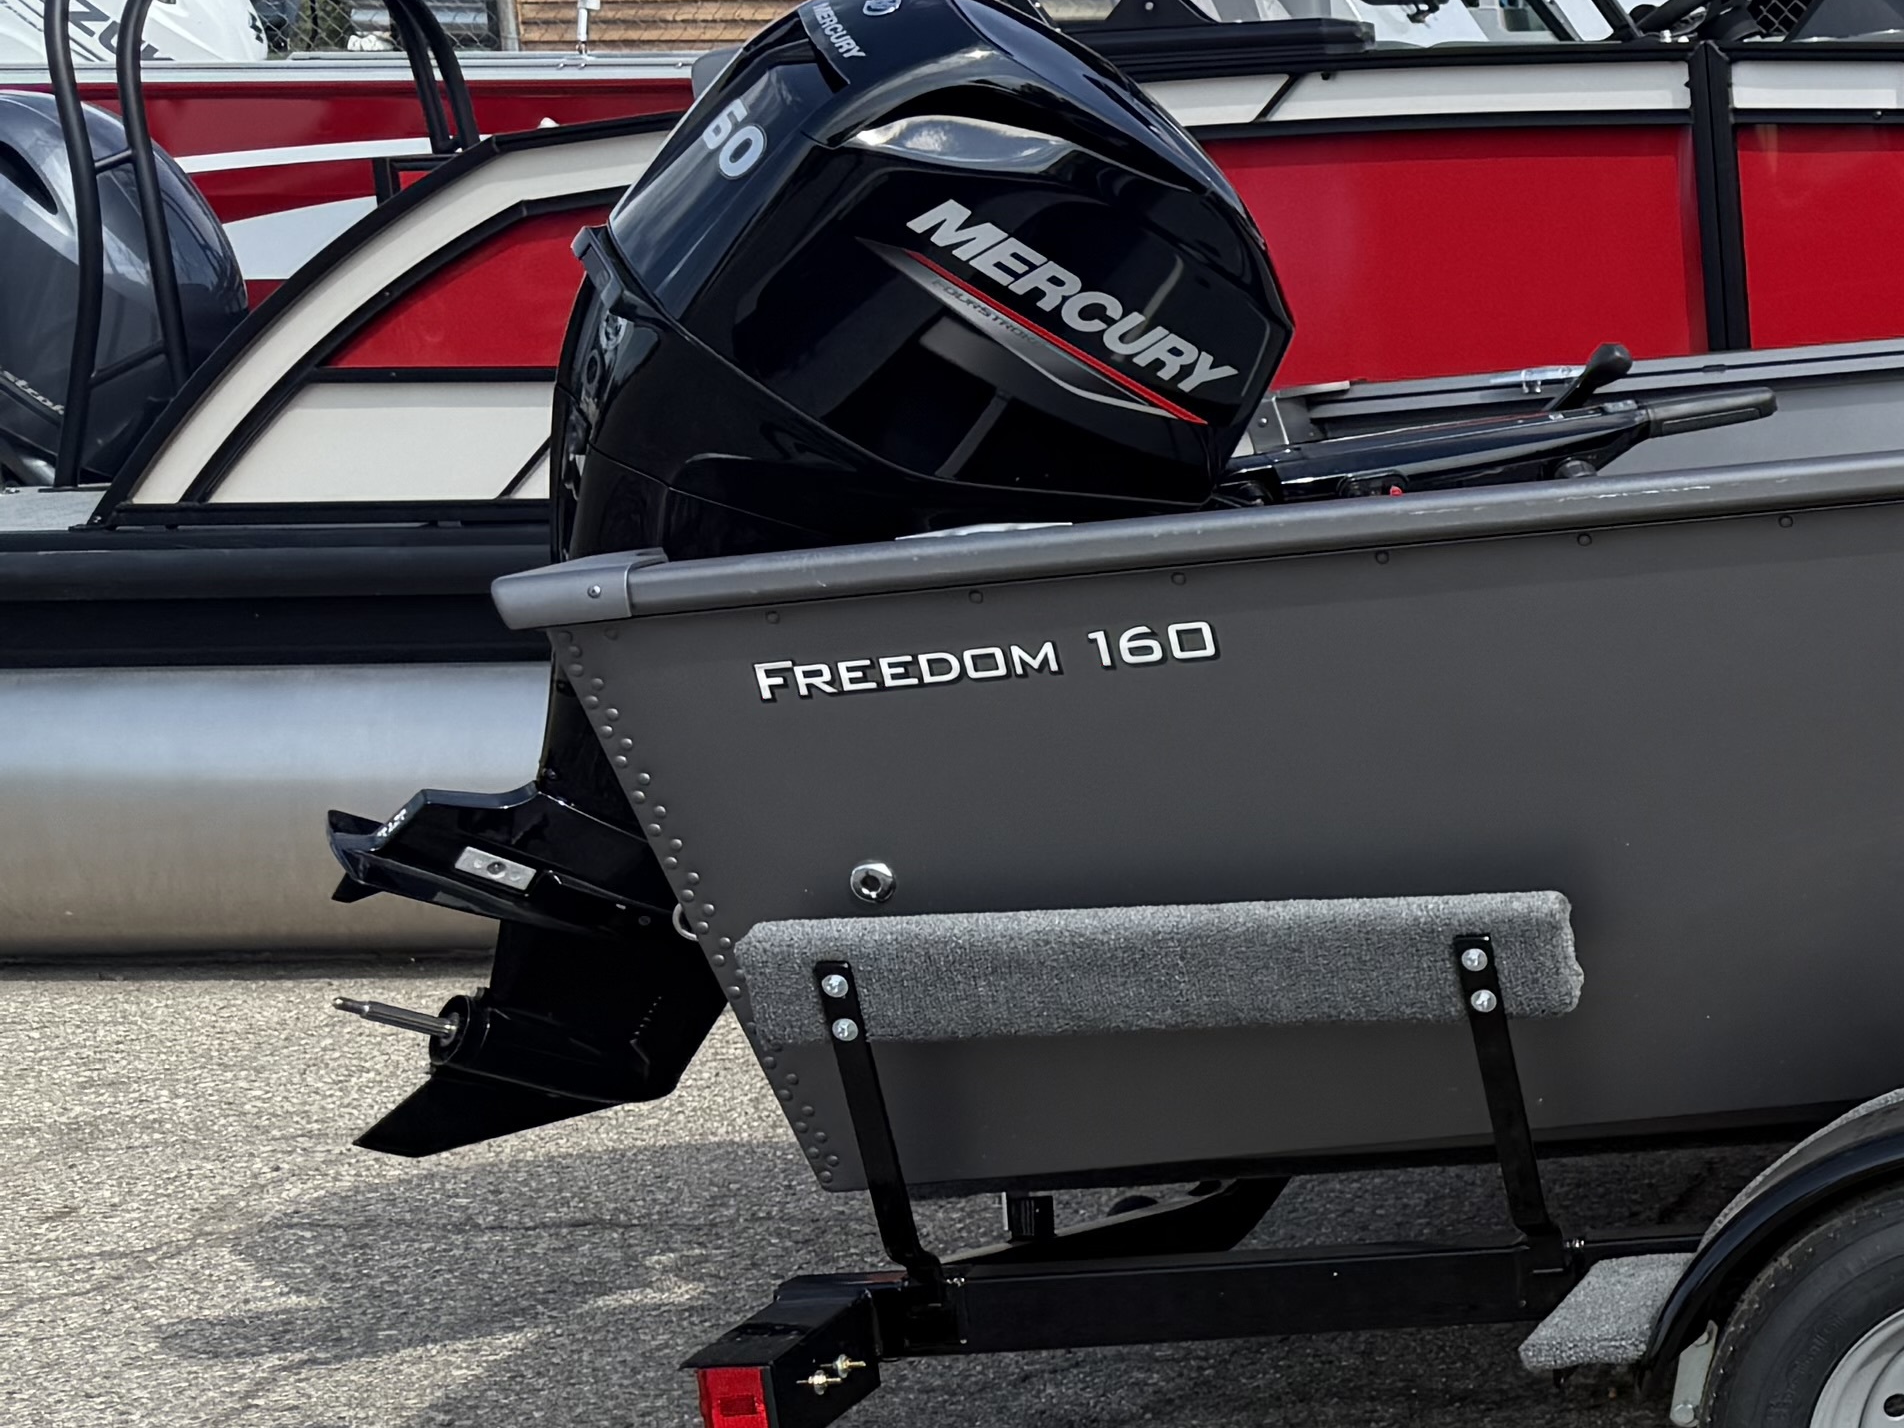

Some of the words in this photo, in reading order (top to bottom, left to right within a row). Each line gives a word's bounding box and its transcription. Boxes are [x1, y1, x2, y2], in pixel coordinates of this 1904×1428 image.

[812, 2, 867, 59] MERCURY
[906, 198, 1239, 393] MERCURY
[753, 640, 1064, 703] FREEDOM
[1086, 620, 1221, 669] 160
